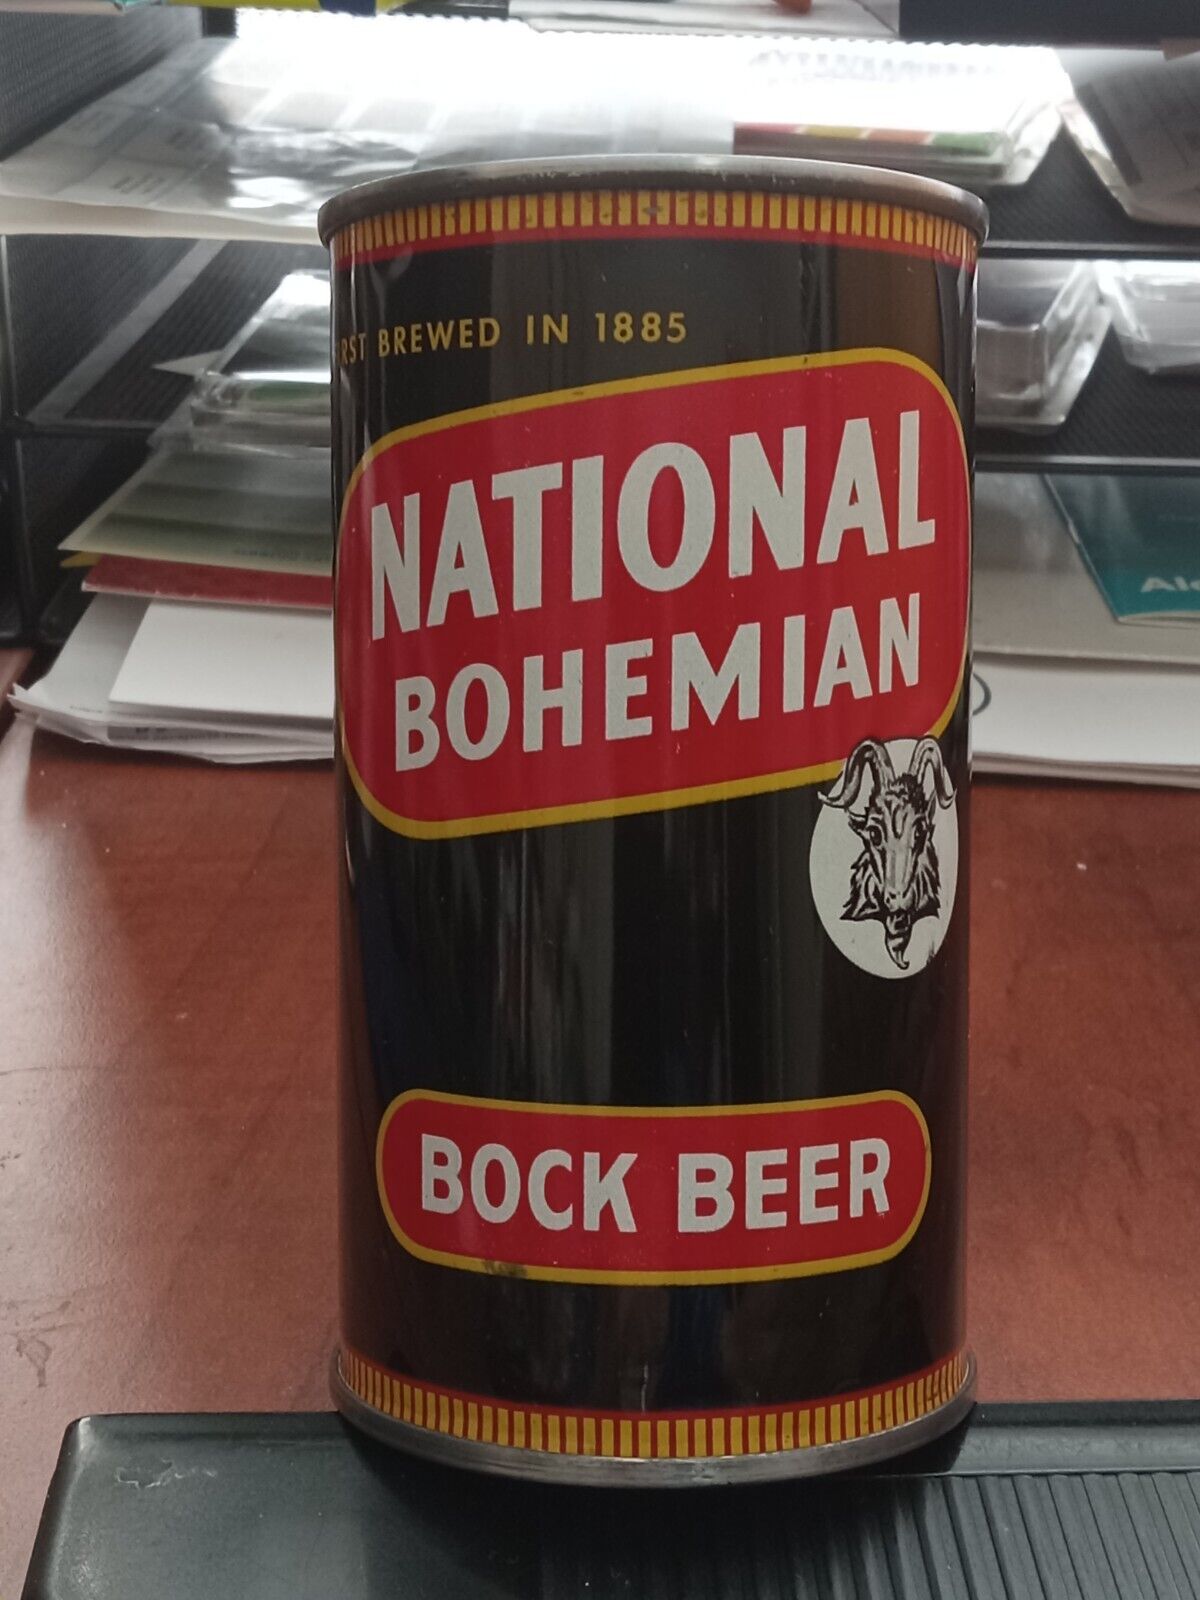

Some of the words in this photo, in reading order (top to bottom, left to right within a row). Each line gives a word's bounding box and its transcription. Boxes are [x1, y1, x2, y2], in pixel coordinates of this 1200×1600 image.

[379, 317, 500, 357] BREWED
[526, 314, 569, 345] IN
[595, 312, 687, 343] 1885
[371, 410, 936, 641] NATIONAL
[395, 592, 921, 772] BOHEMIAN
[421, 1133, 638, 1233] BOCK
[678, 1138, 891, 1233] BEER
